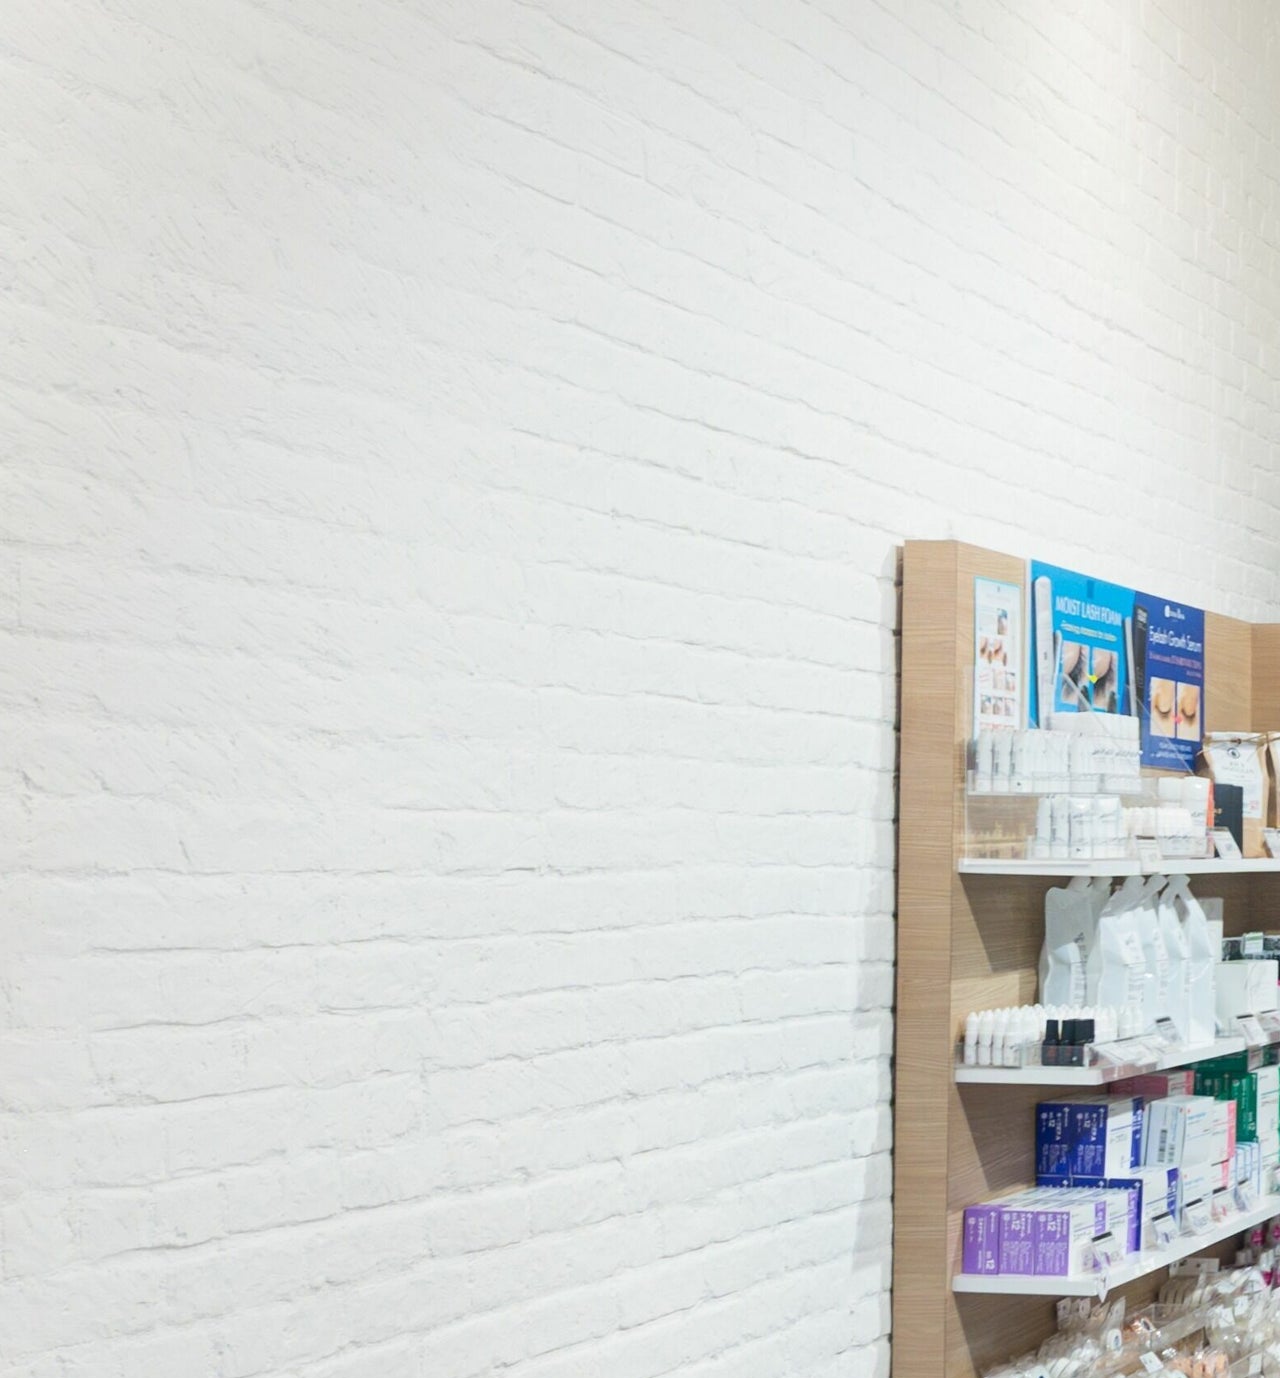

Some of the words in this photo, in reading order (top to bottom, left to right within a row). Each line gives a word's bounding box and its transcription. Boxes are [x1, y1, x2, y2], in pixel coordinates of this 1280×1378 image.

[1056, 596, 1080, 616] MOIST
[1082, 601, 1101, 621] LASH
[1149, 626, 1168, 646] Eyelash
[1168, 630, 1187, 649] Growth
